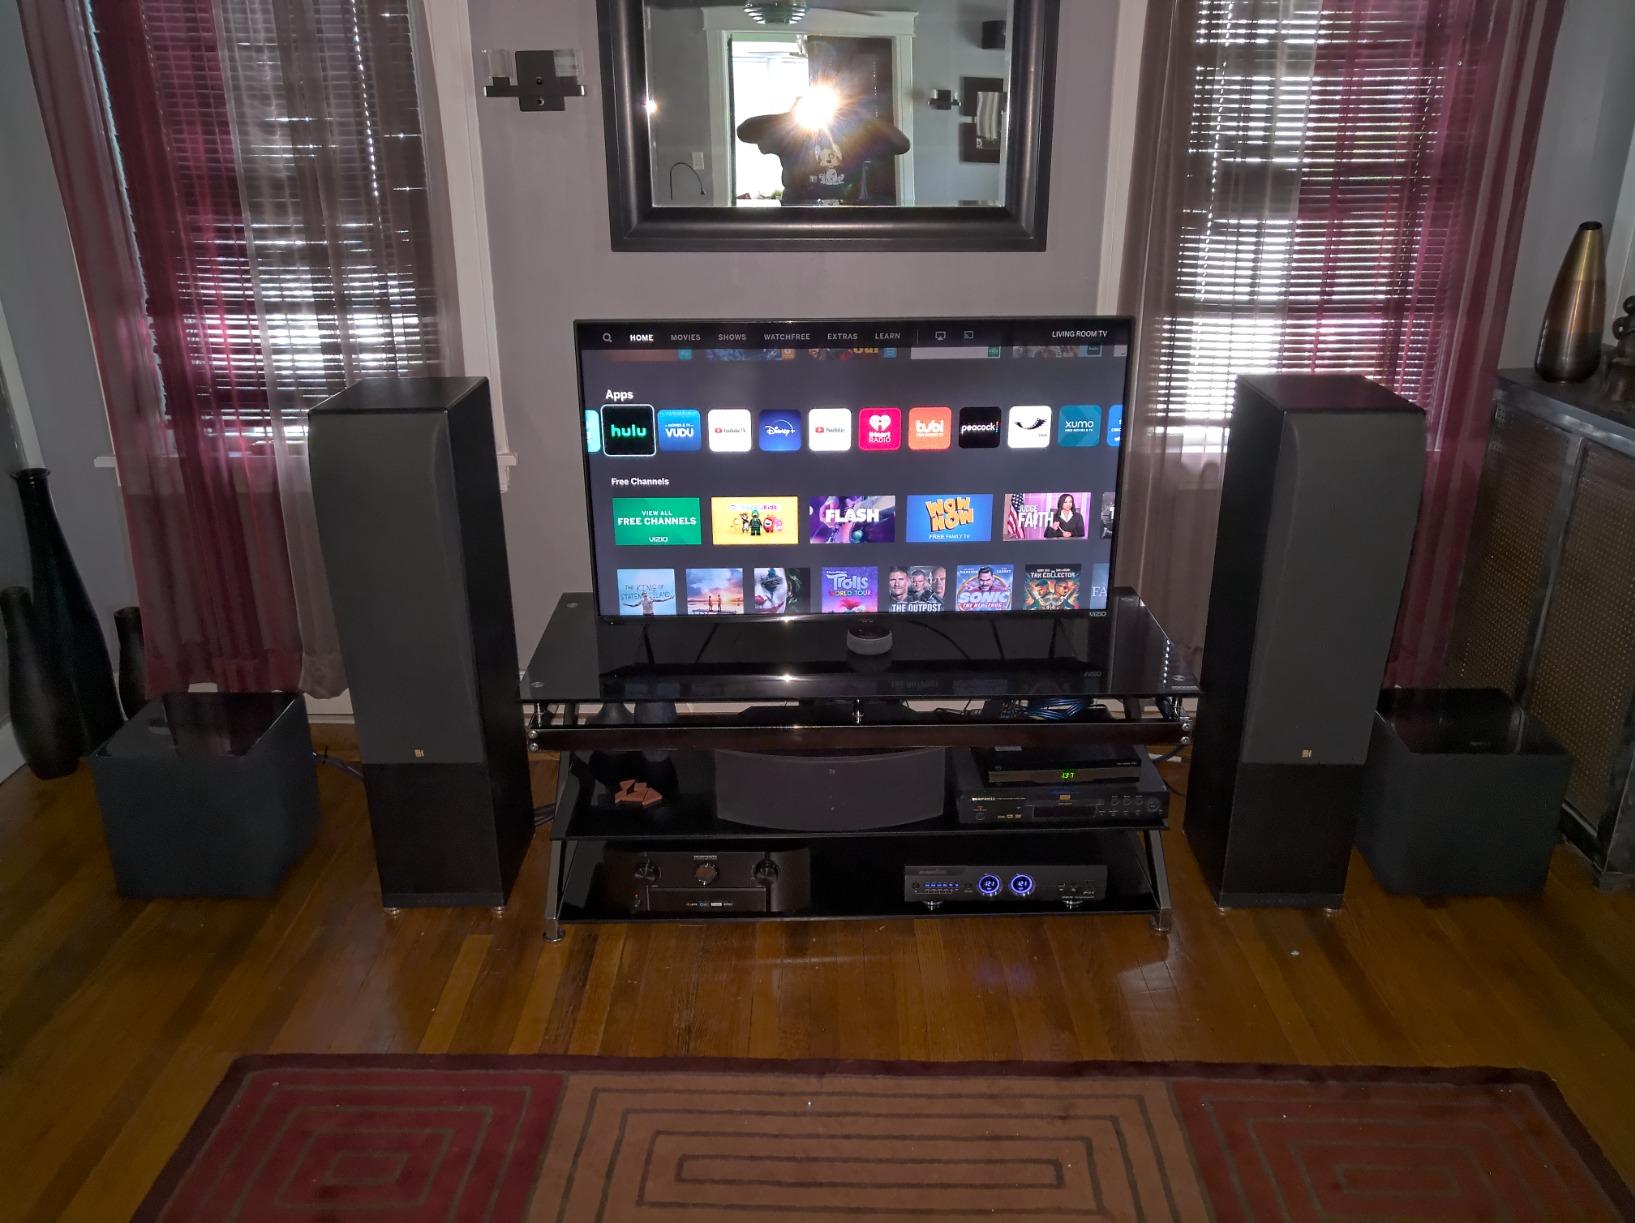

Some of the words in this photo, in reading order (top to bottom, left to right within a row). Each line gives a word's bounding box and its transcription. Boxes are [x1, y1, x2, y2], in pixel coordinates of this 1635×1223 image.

[629, 334, 654, 342] HOME
[718, 333, 747, 341] SHOWS
[764, 333, 811, 341] WATCHFREE
[875, 332, 900, 340] LEARN
[605, 389, 634, 402] Apps
[611, 424, 647, 437] hulu
[665, 428, 694, 438] VUDU
[765, 426, 795, 436] Disney+
[961, 422, 995, 435] peacock
[926, 497, 970, 518] WOW
[826, 509, 879, 522] FLASH
[931, 508, 974, 531] NOW
[1018, 512, 1054, 528] FAITH
[826, 574, 869, 590] Trolls
[958, 591, 1010, 603] SONIC
[892, 604, 907, 612] THE
[908, 604, 942, 612] OUTPOST
